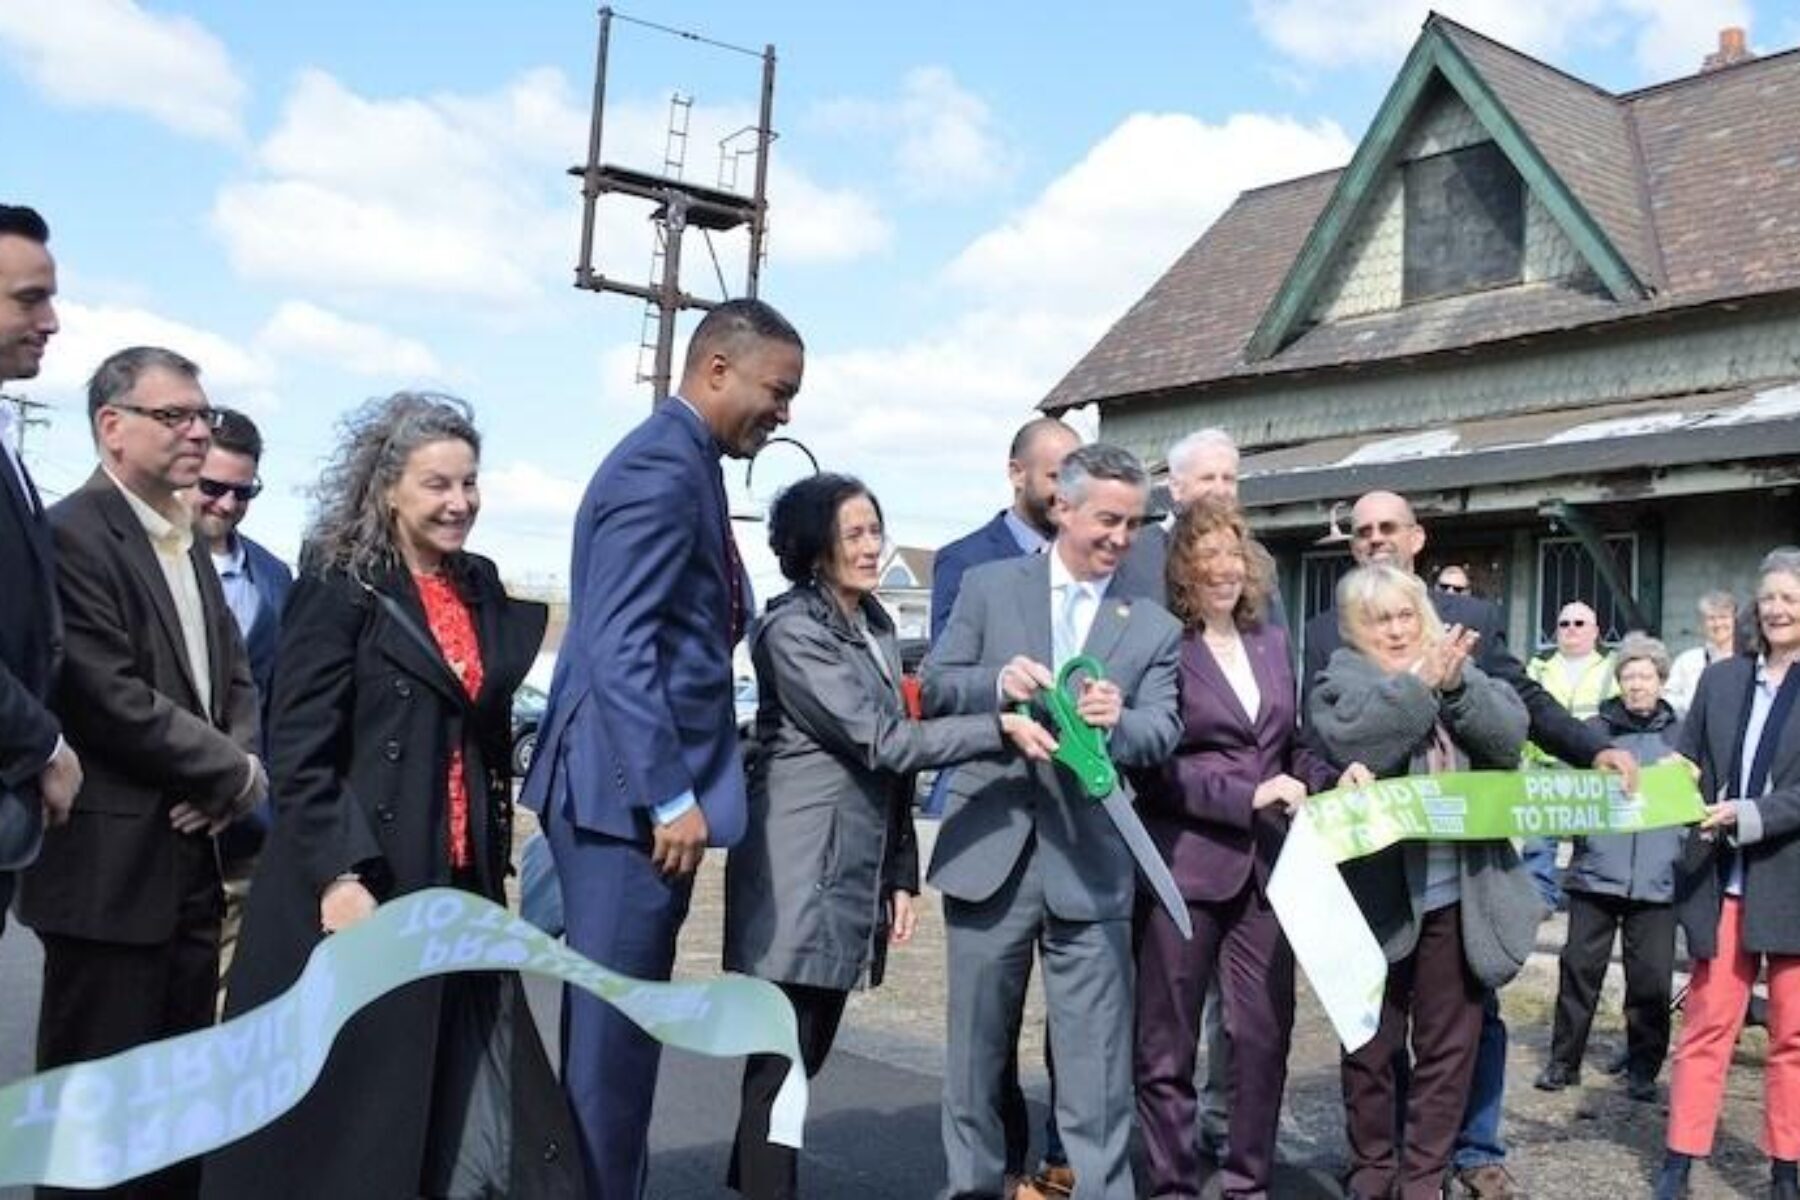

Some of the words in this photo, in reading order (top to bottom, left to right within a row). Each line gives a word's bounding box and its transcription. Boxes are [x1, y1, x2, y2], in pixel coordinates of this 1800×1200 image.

[1526, 774, 1603, 800] PROUD
[1512, 805, 1542, 831] TO
[1544, 804, 1605, 831] TRAIL
